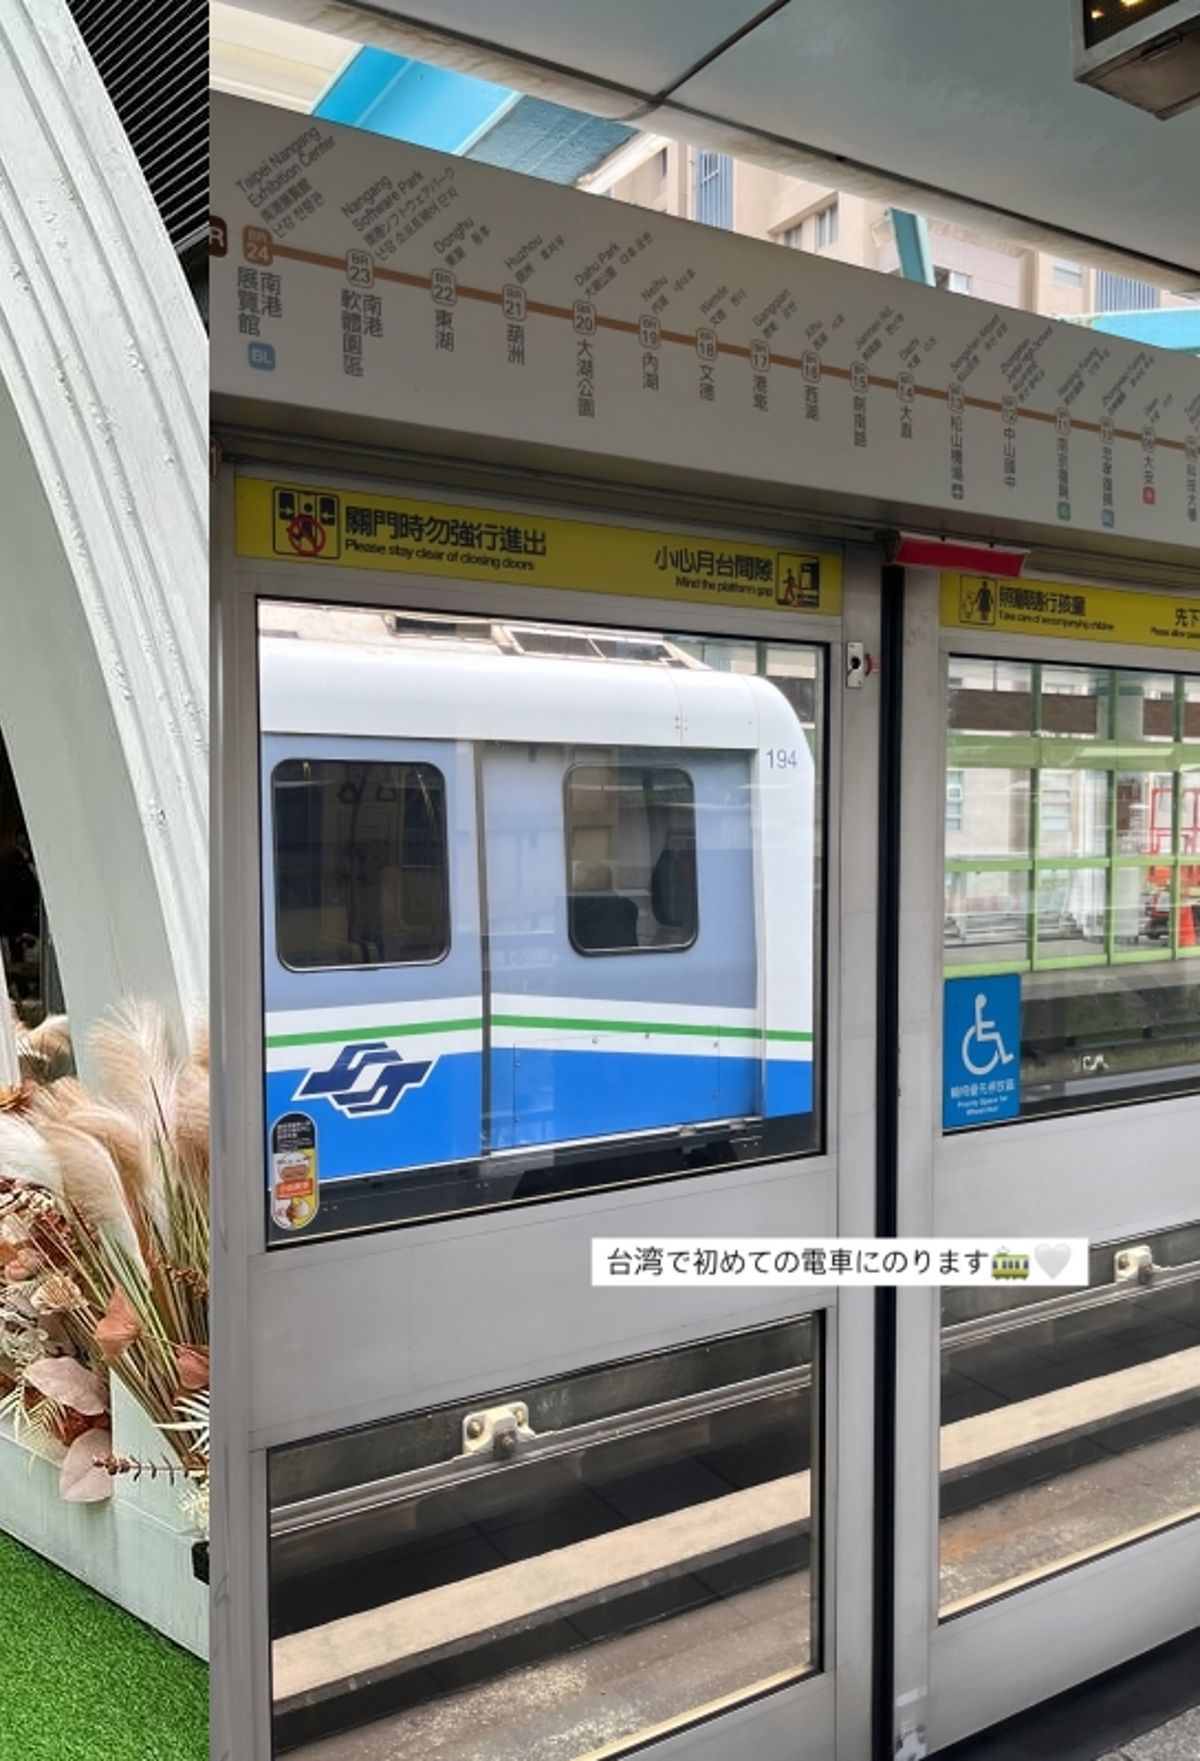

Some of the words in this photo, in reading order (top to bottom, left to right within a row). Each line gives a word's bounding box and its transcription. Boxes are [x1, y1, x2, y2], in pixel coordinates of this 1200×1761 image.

[235, 161, 272, 193] Taipei
[269, 127, 322, 167] Nangang
[248, 163, 302, 208] Exhibition
[299, 136, 336, 167] Center
[341, 176, 393, 219] Nangang
[352, 191, 401, 232] Software
[398, 170, 425, 193] Park
[246, 243, 269, 262] 24
[433, 217, 474, 254] Donghu
[504, 235, 543, 270] Huzhou
[350, 267, 371, 284] 23
[433, 284, 453, 301] 22
[237, 266, 260, 337] 展覽館
[260, 272, 283, 319] 南港
[506, 301, 522, 317] 21
[363, 294, 383, 338] 南港
[435, 309, 454, 352] 東湖
[576, 315, 593, 331] 20
[643, 329, 658, 346] 19
[700, 342, 715, 358] 18
[252, 348, 273, 364] BL
[577, 339, 595, 418] 大湖公園
[345, 505, 546, 556] 關門時勿強行進出
[345, 538, 386, 555] Please
[388, 543, 413, 560] stay
[415, 547, 445, 562] clear
[446, 550, 459, 562] of
[460, 552, 500, 570] closing
[502, 557, 535, 571] doors
[654, 545, 774, 582] 小心月台間隙
[675, 575, 700, 589] Mind
[702, 578, 716, 590] the
[717, 581, 756, 595] platform
[766, 748, 798, 769] 194
